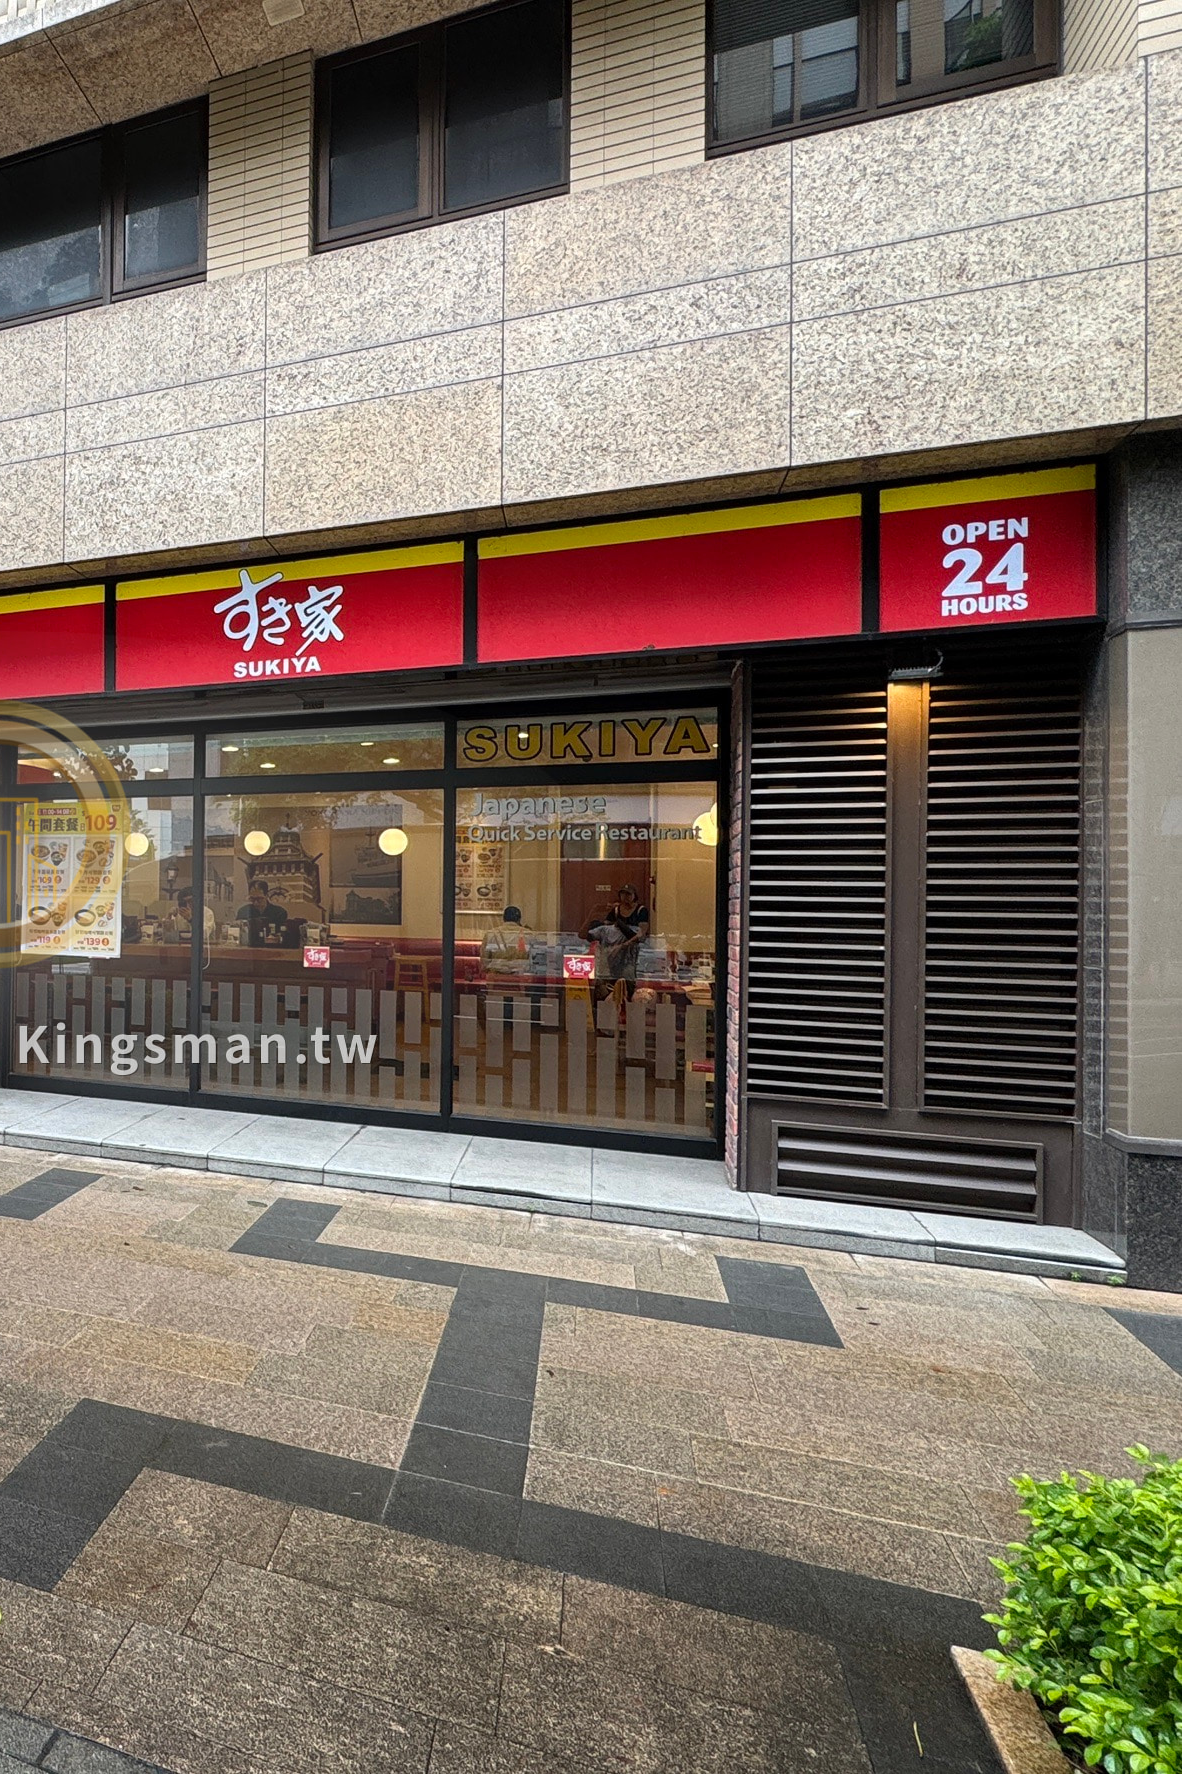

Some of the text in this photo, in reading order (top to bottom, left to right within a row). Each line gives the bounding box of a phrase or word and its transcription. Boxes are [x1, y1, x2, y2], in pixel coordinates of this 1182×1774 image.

[942, 517, 1029, 545] OPEN
[941, 542, 1029, 597] 24
[213, 569, 344, 656] すき家
[941, 593, 1029, 617] HOURS
[233, 656, 321, 678] SUKIYA
[463, 715, 711, 762] SUKIYA
[470, 793, 606, 820] Japanese
[468, 823, 520, 843] Quick
[524, 824, 592, 842] Service
[595, 824, 702, 841] Restaurant
